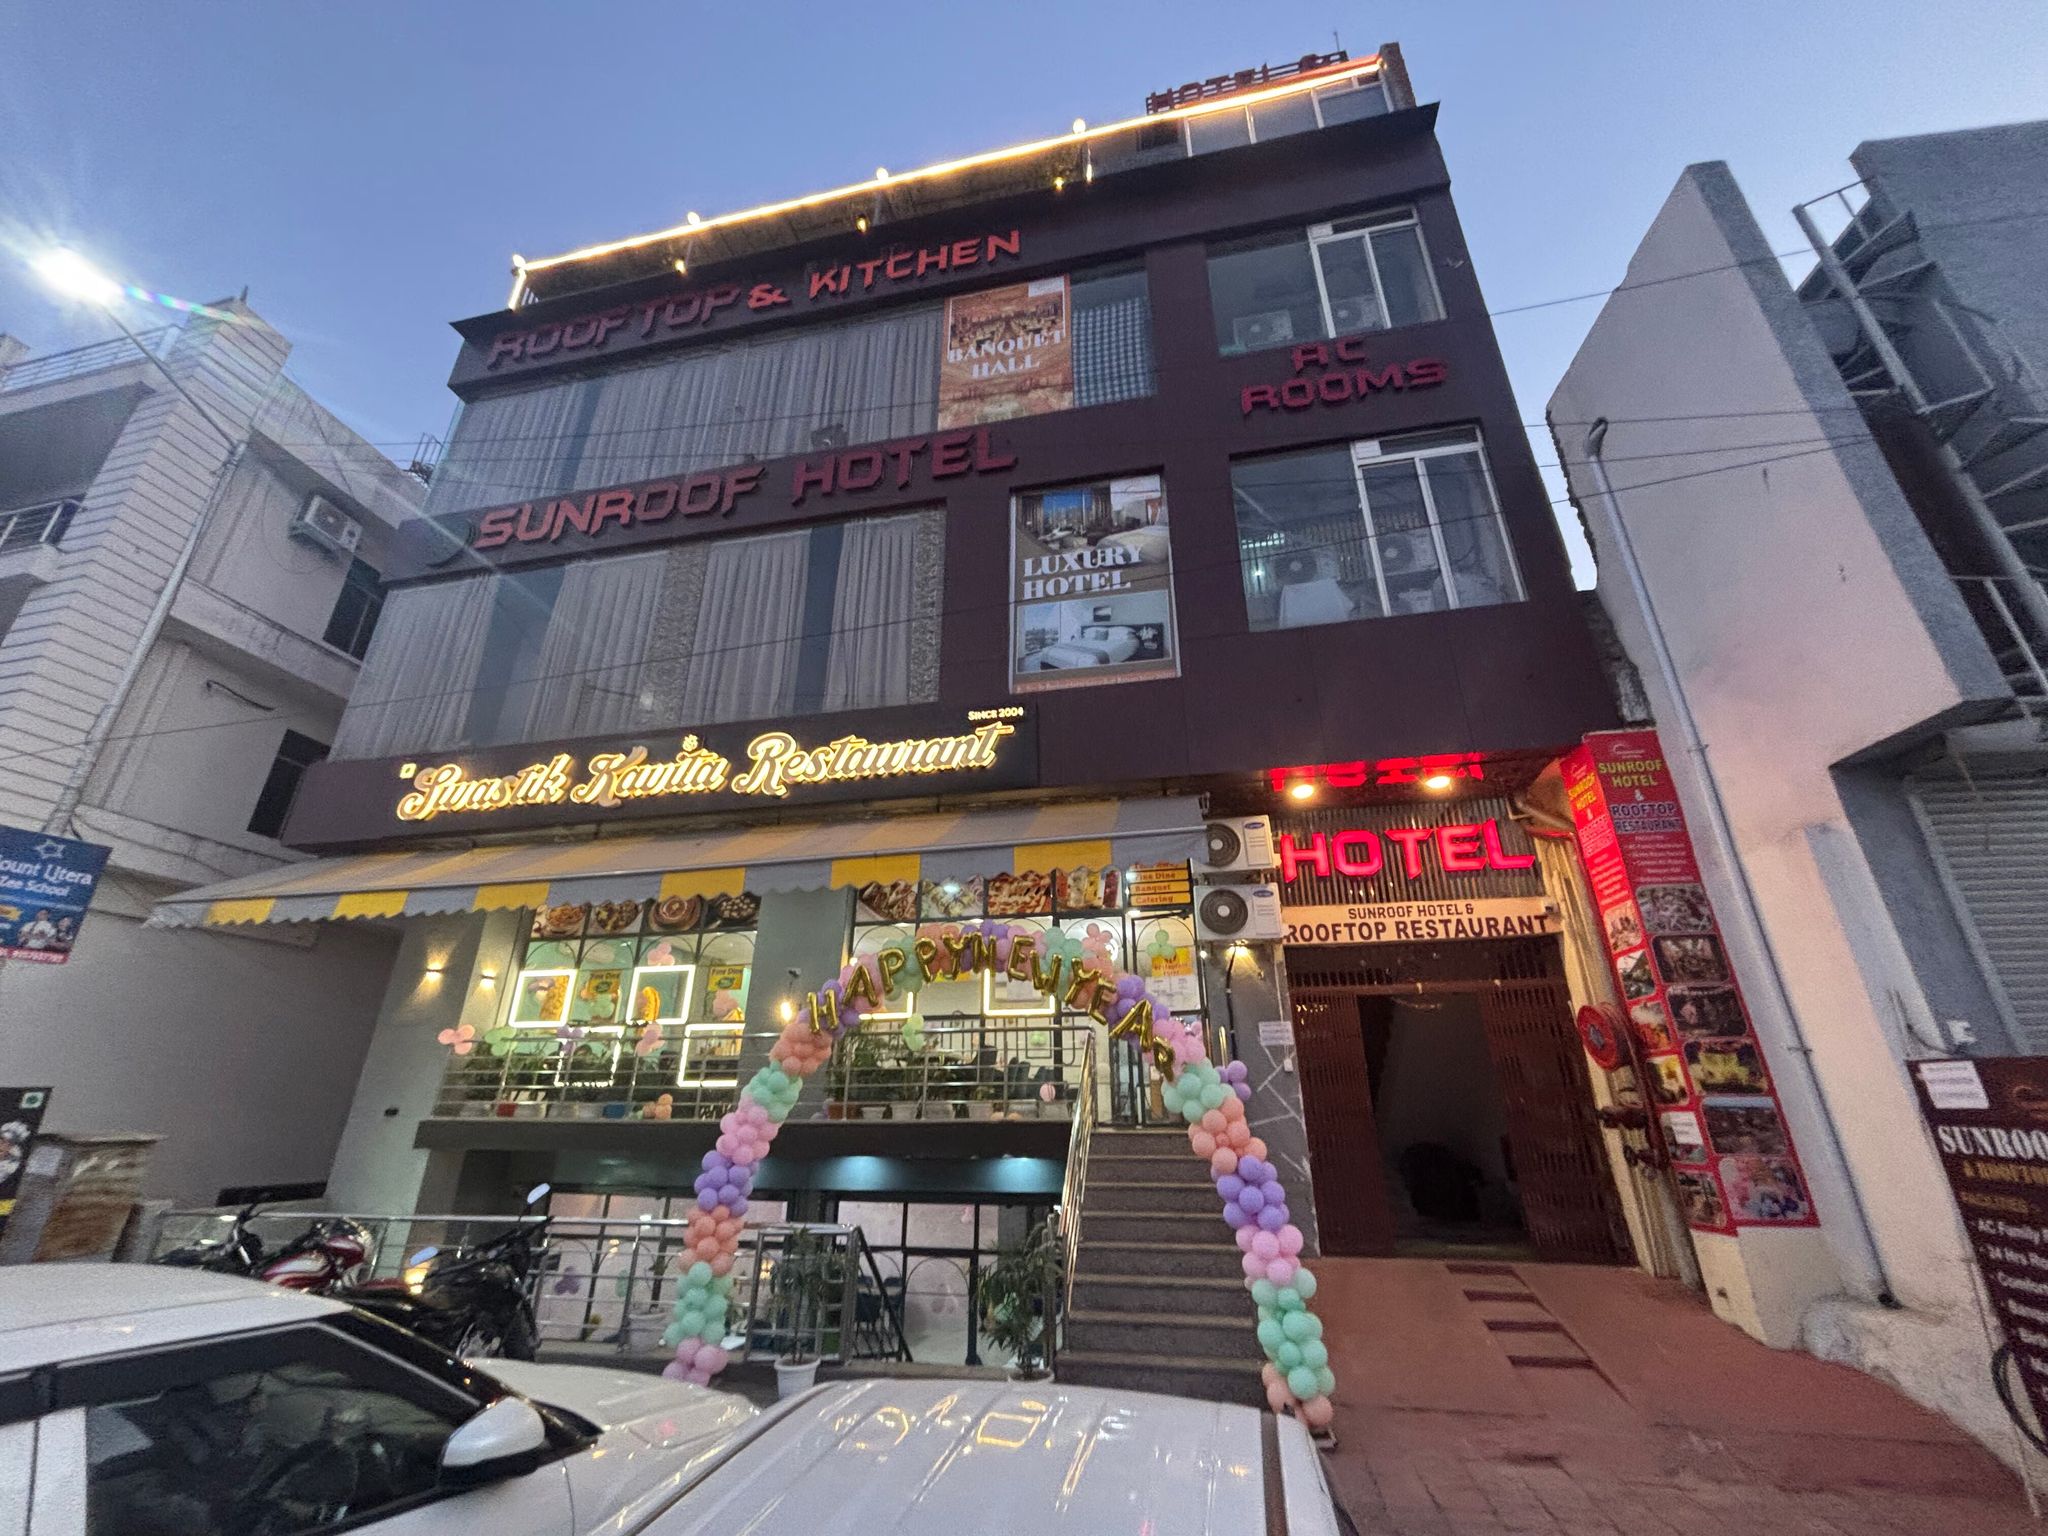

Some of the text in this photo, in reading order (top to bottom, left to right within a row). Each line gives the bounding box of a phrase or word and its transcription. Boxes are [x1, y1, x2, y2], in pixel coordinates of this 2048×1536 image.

[487, 230, 1021, 368] ROOFTOP & KITCHEN
[948, 329, 1063, 363] BANQUET
[972, 353, 1040, 378] HALL
[1241, 357, 1448, 414] ROOMS
[473, 428, 1019, 551] SUNROOF HOTEL
[1023, 543, 1143, 577] LUXURY
[1022, 570, 1131, 601] HOTEL
[968, 706, 1024, 721] SINCE 2004
[397, 753, 572, 821] Swastik
[731, 721, 1015, 797] Restaurant
[1599, 760, 1663, 774] SUNROOF
[1611, 775, 1658, 788] HOTEL
[1610, 802, 1677, 817] ROOFTOP
[1280, 817, 1536, 884] HOTEL
[1348, 903, 1474, 920] SUNROOF HOTEL &
[1284, 915, 1549, 943] ROOFTOP RESTAURANT
